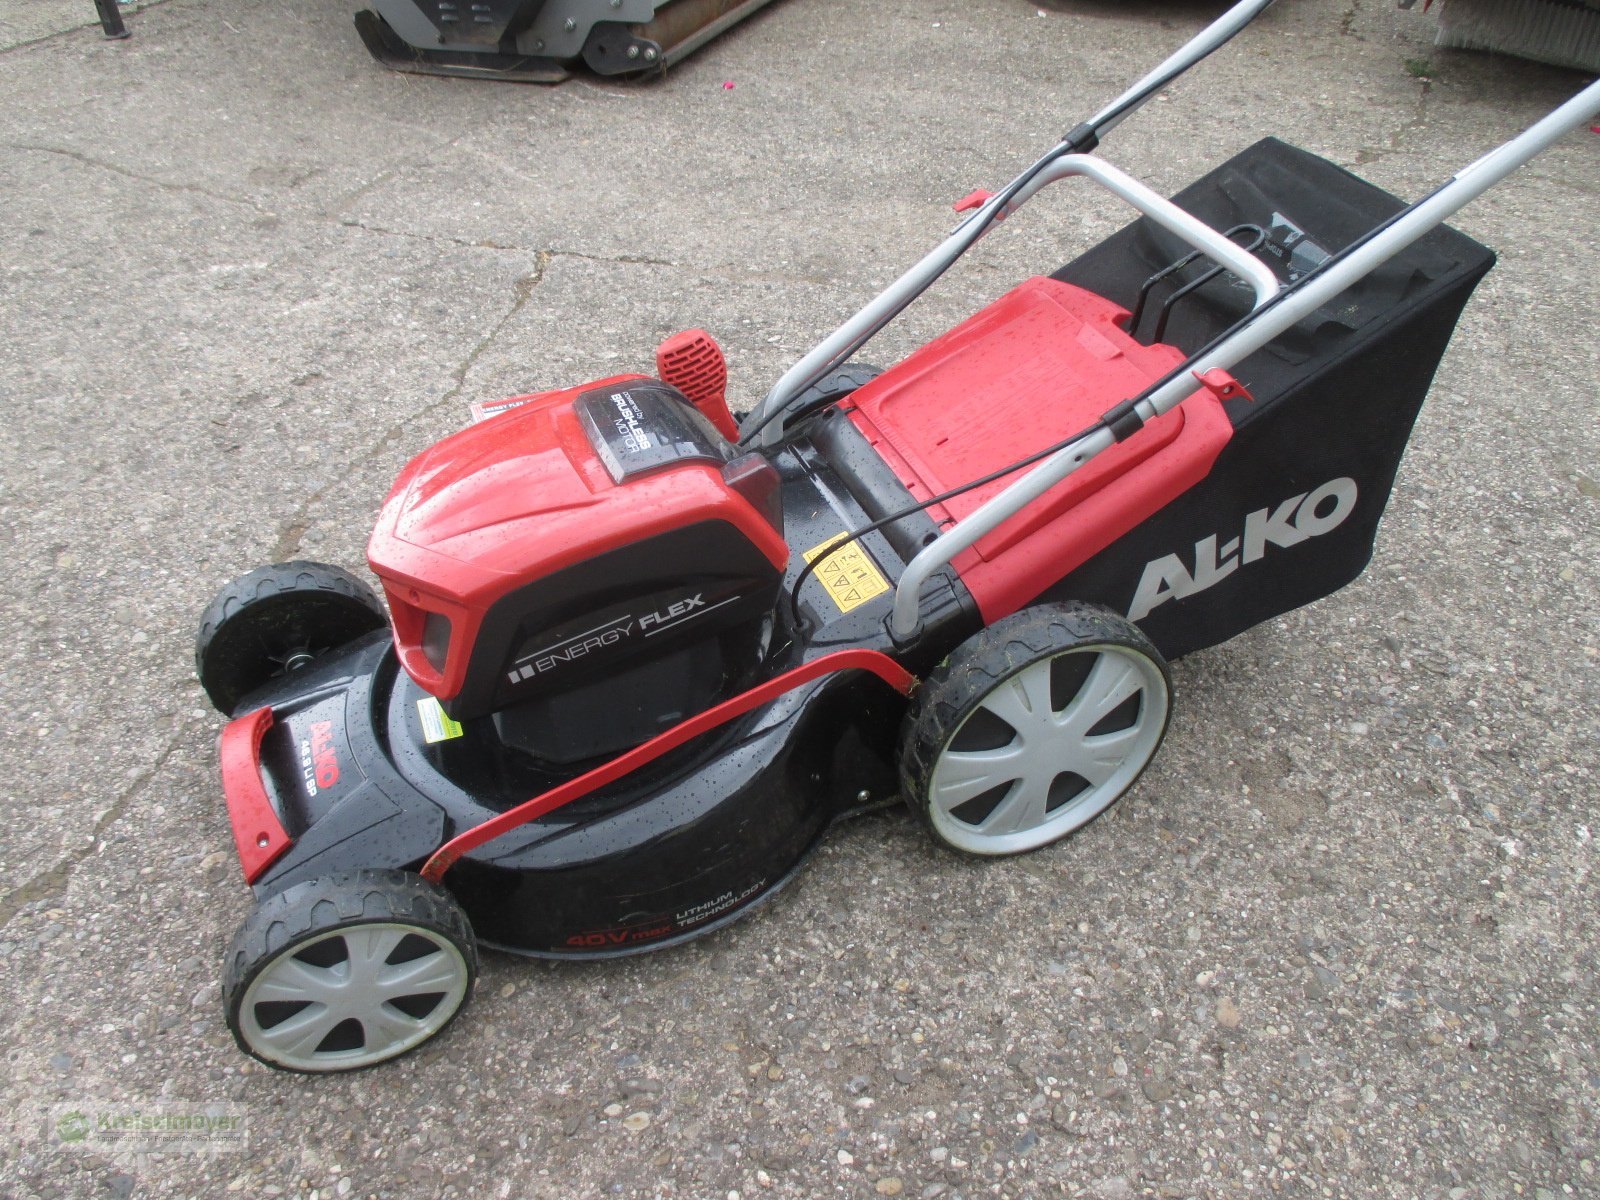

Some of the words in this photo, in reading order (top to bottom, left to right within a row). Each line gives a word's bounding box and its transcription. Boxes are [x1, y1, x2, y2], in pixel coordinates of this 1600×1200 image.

[611, 393, 651, 449] BRUSHLESS
[622, 391, 642, 412] powered
[613, 418, 640, 454] MOTOR
[1126, 477, 1358, 622] AL-KO
[535, 622, 634, 673] ENERGY
[639, 593, 706, 630] FLEX
[310, 720, 340, 789] AL-KO
[306, 778, 318, 797] SP
[676, 891, 733, 920] LITHIUM
[677, 877, 767, 928] TECHNOLOGY
[632, 925, 673, 940] max
